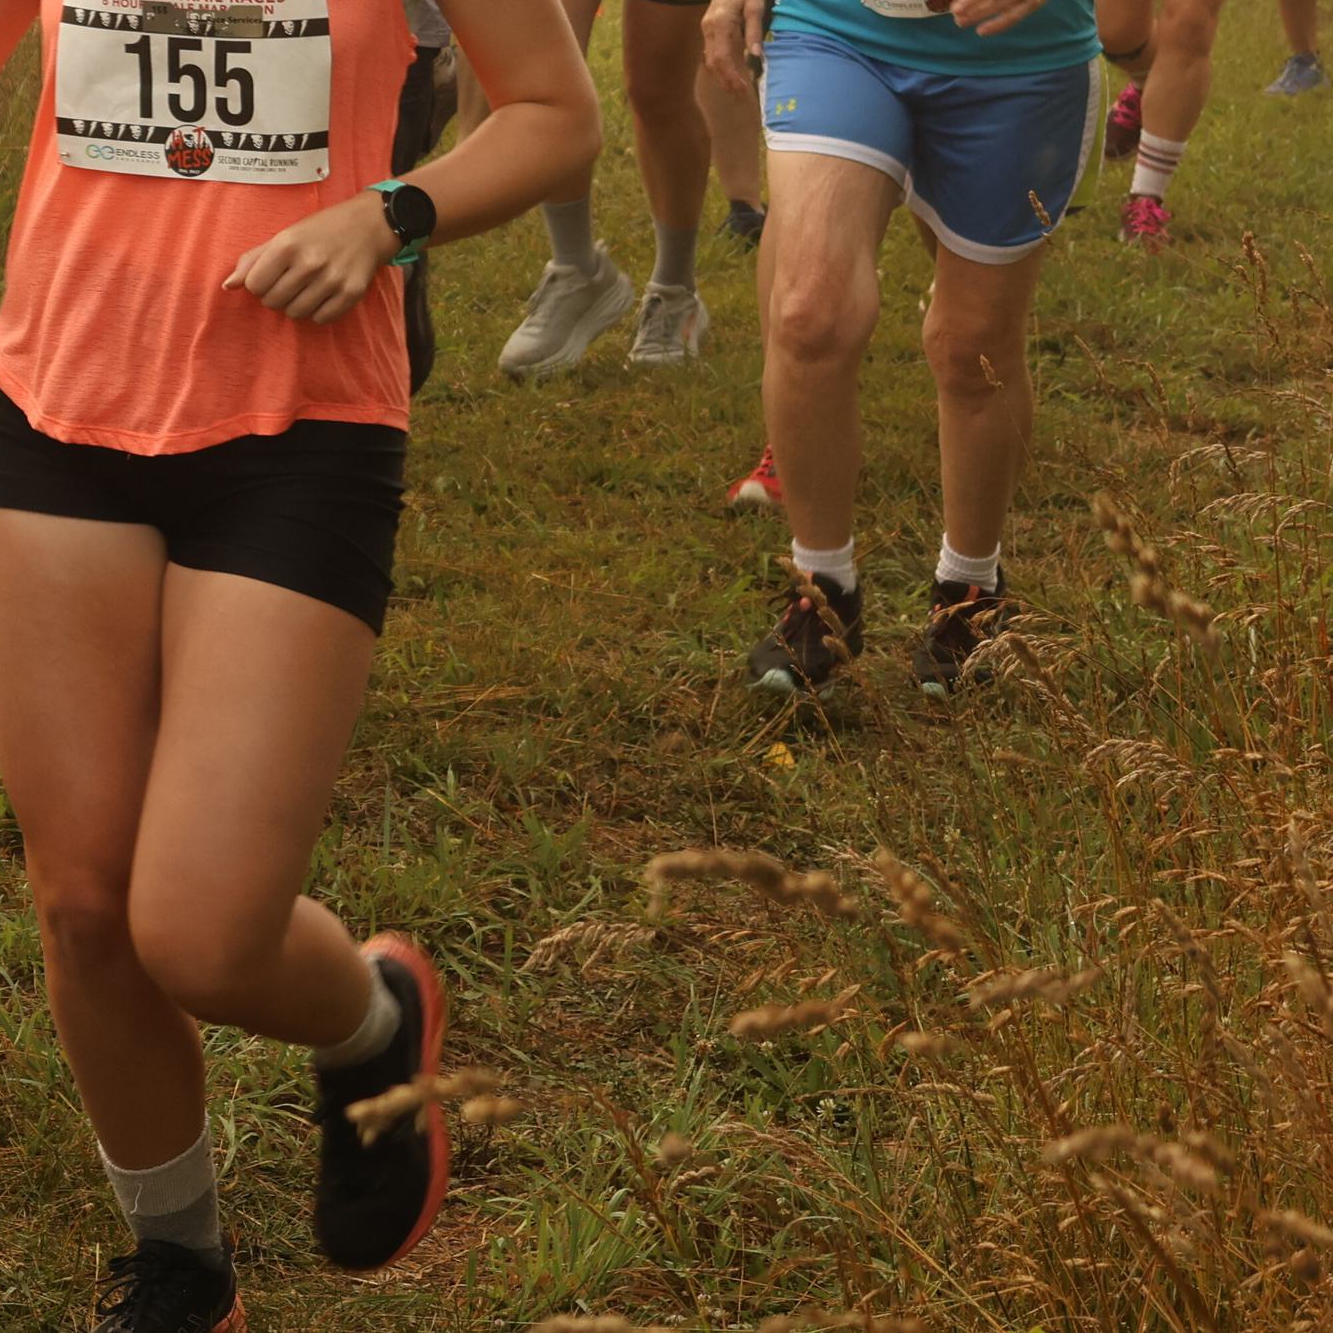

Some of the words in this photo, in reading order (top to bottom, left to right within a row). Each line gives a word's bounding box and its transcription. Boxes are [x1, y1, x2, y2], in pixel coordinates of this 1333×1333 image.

[124, 35, 255, 127] 155
[116, 149, 161, 160] ENDLESS
[167, 148, 211, 169] MESS
[217, 155, 241, 165] SECOND
[242, 157, 268, 167] CAPITAL
[269, 158, 299, 167] RUNNING
